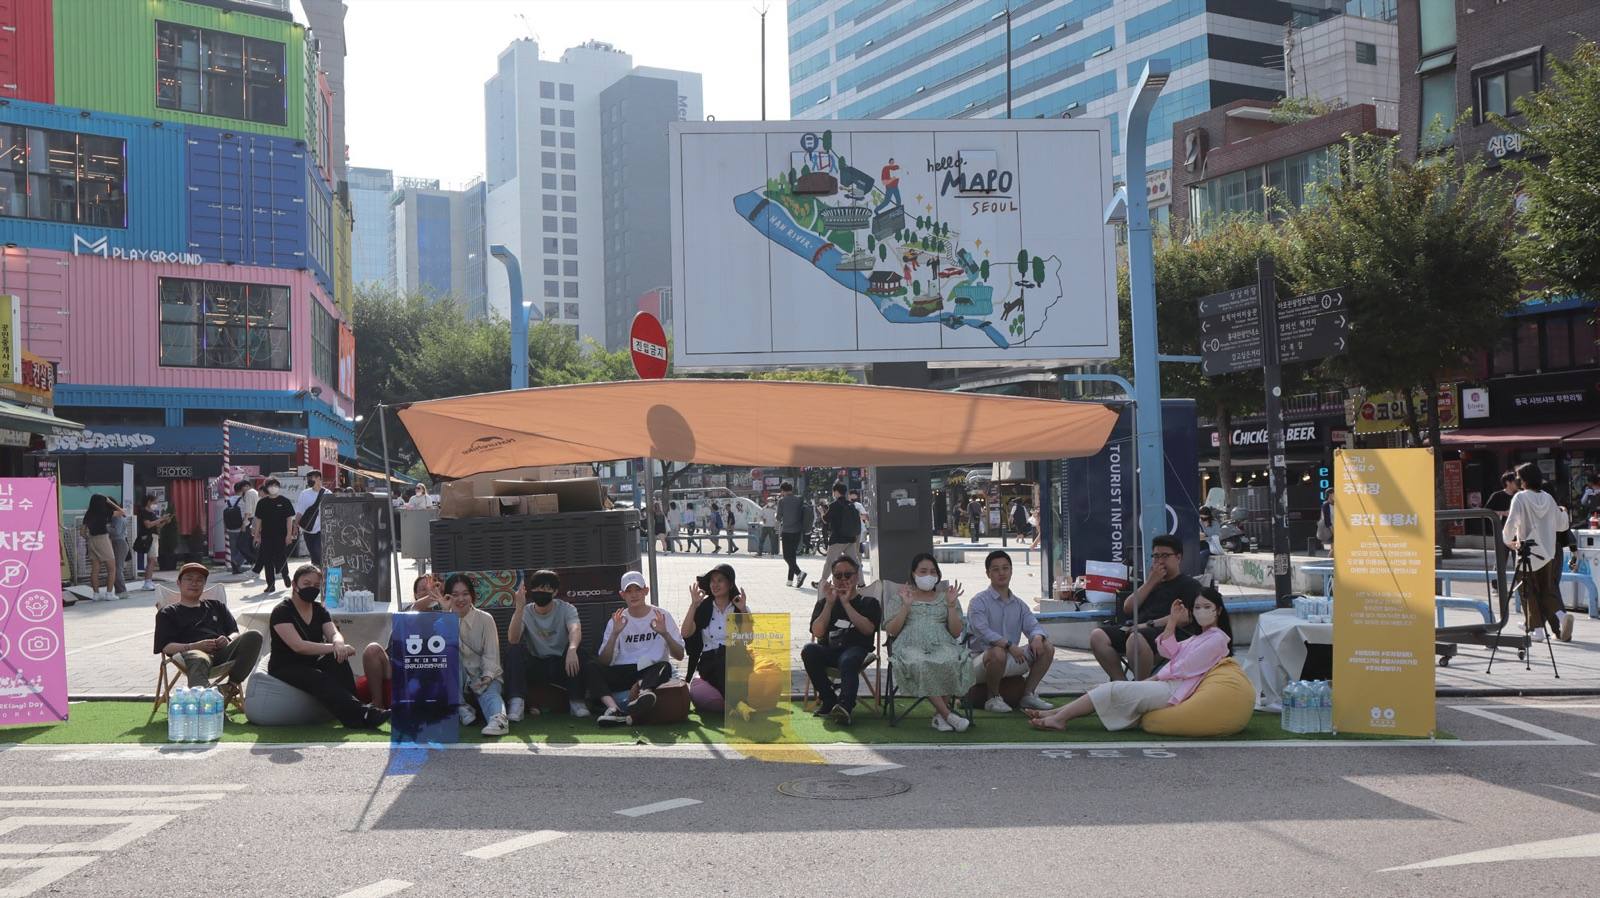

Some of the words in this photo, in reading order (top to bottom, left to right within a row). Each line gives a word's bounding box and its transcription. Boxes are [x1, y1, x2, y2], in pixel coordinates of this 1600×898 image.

[941, 169, 1013, 196] MAPO
[972, 201, 1018, 216] SEOUL
[787, 229, 811, 249] RIVER
[112, 246, 203, 266] PLAYGROUND
[635, 340, 664, 358] 진입금지
[1232, 429, 1269, 446] CHICKE
[1286, 426, 1316, 442] BEER
[1109, 444, 1122, 505] TOURIST
[1343, 482, 1380, 495] 주차장
[18, 498, 33, 511] 수
[625, 632, 659, 643] NERDY
